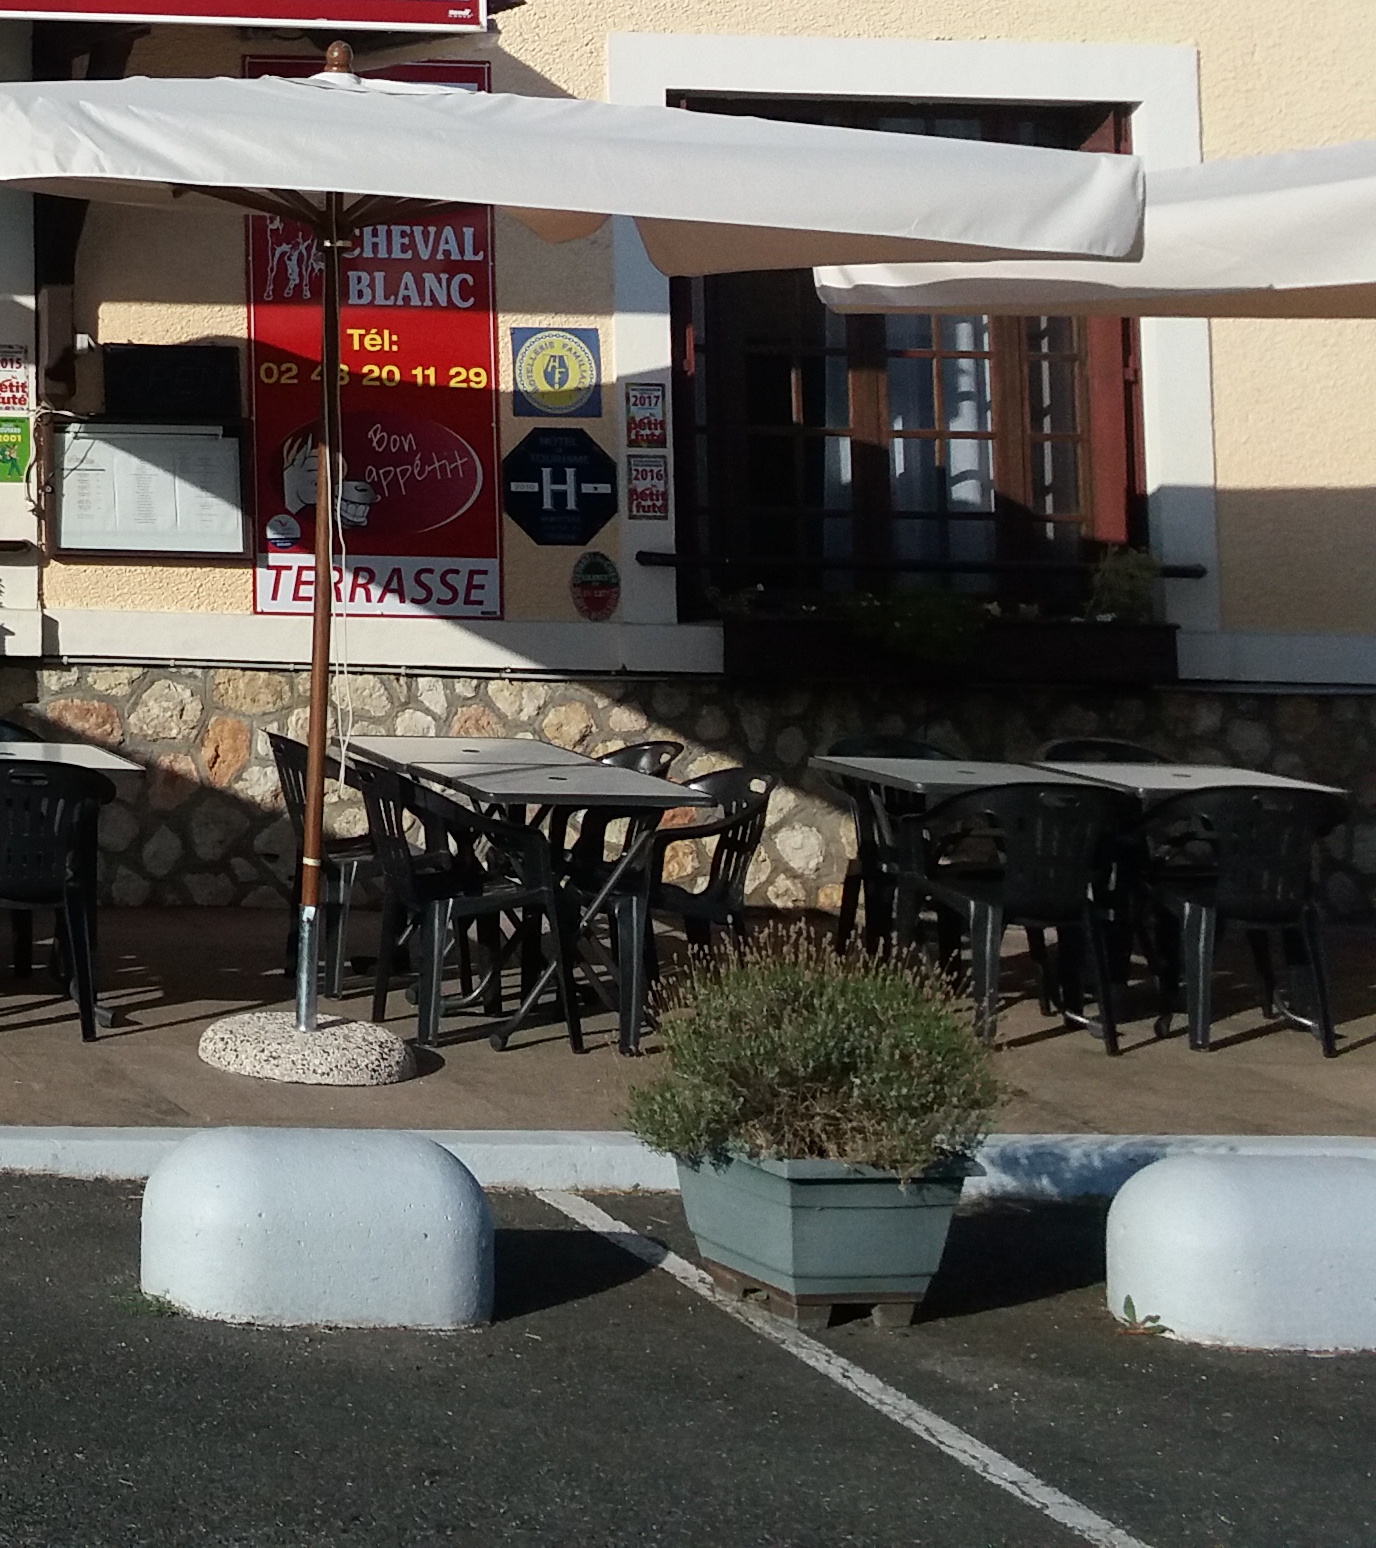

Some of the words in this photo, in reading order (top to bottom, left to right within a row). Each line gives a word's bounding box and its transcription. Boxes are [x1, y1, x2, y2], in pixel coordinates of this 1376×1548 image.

[346, 270, 476, 309] BLANC
[346, 328, 400, 353] Tél:
[259, 361, 299, 385] 02
[361, 364, 401, 388] 20
[411, 365, 436, 388] 11
[448, 366, 488, 390] 29
[632, 394, 660, 408] 2017
[367, 423, 417, 453] Bon
[365, 450, 469, 497] appétit
[633, 468, 663, 481] 2016
[540, 467, 580, 512] H
